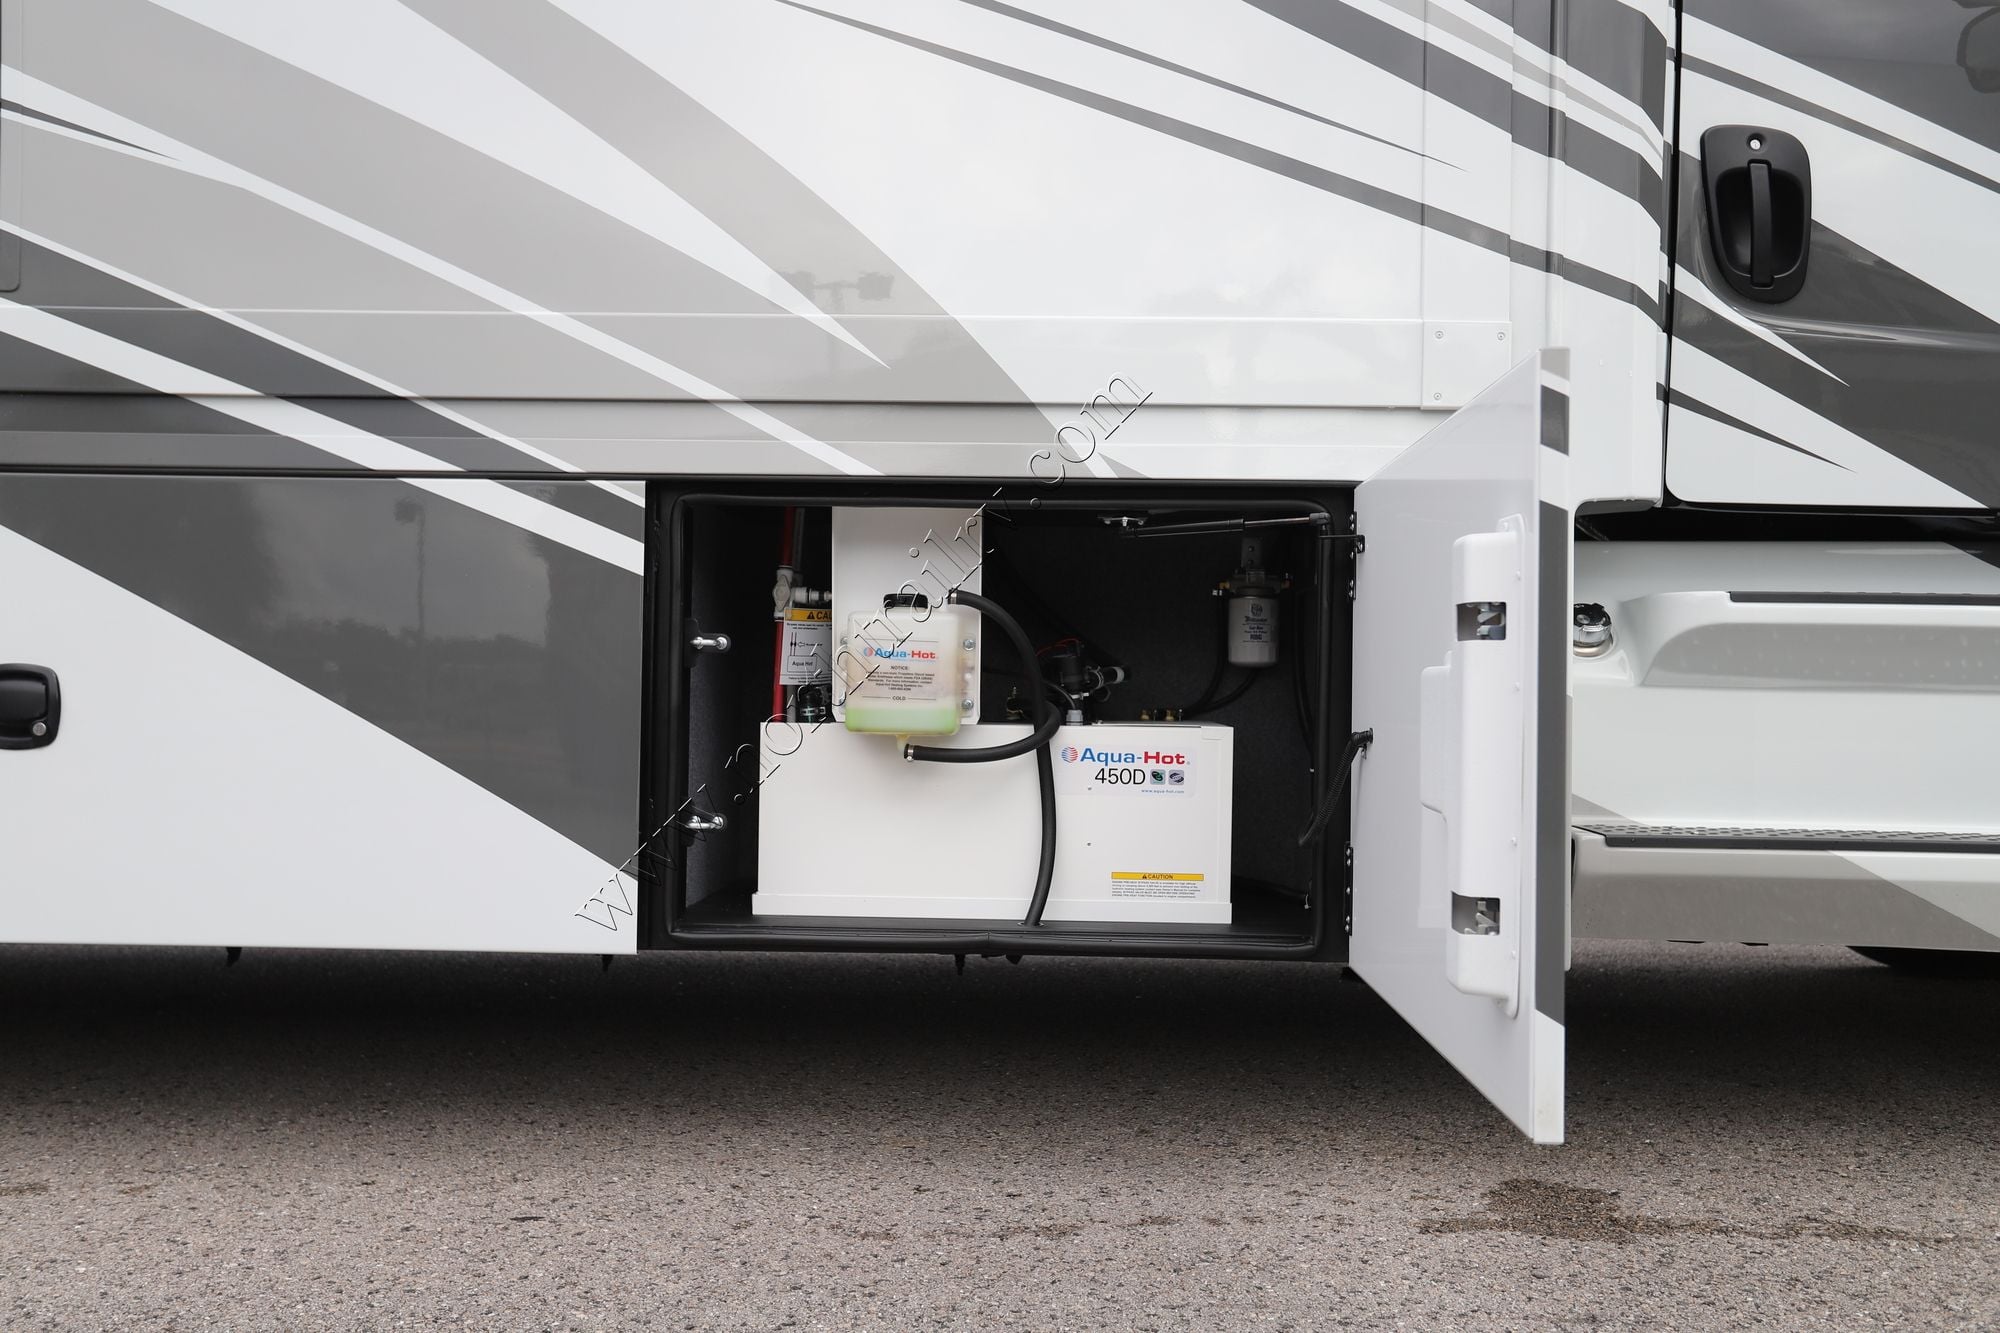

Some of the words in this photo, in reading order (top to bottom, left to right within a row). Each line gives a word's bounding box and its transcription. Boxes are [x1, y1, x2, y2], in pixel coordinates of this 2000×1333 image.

[874, 647, 936, 660] Aqua-Hot
[1080, 747, 1186, 767] Aqua-Hot
[1094, 767, 1146, 785] 450D
